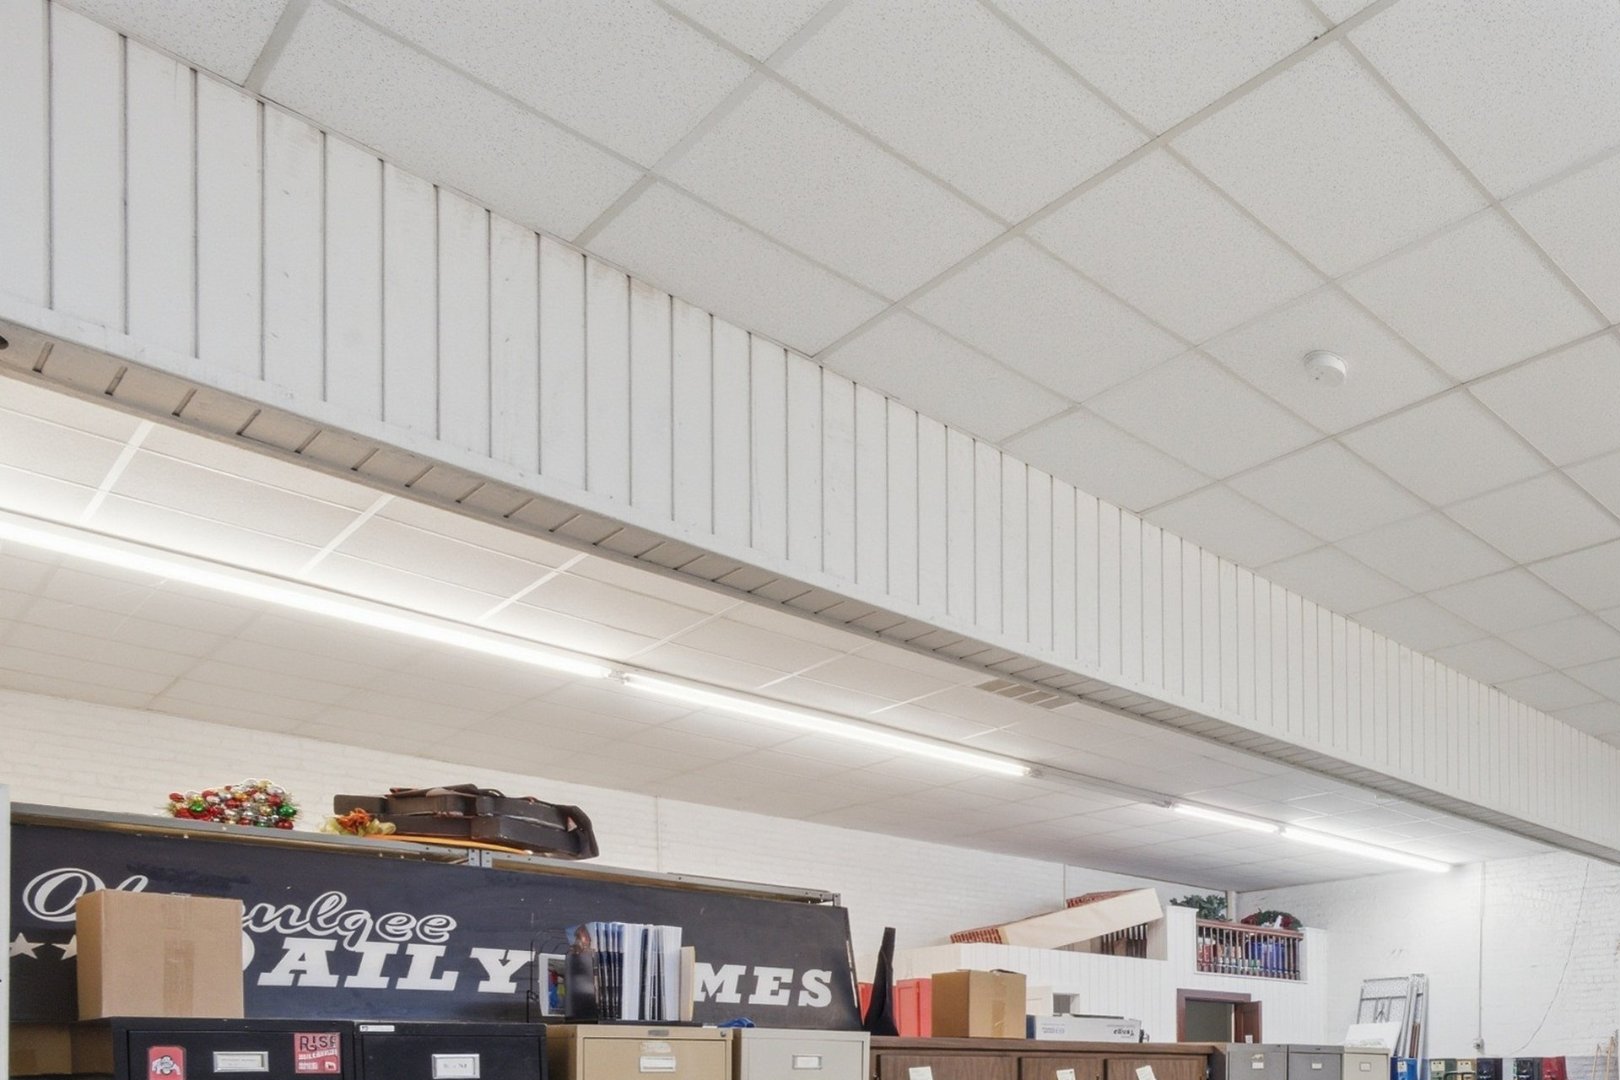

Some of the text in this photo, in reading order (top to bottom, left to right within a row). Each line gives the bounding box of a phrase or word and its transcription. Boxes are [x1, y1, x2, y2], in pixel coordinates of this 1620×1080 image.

[22, 867, 457, 950] Oulgee
[243, 932, 832, 1008] AILY MES
